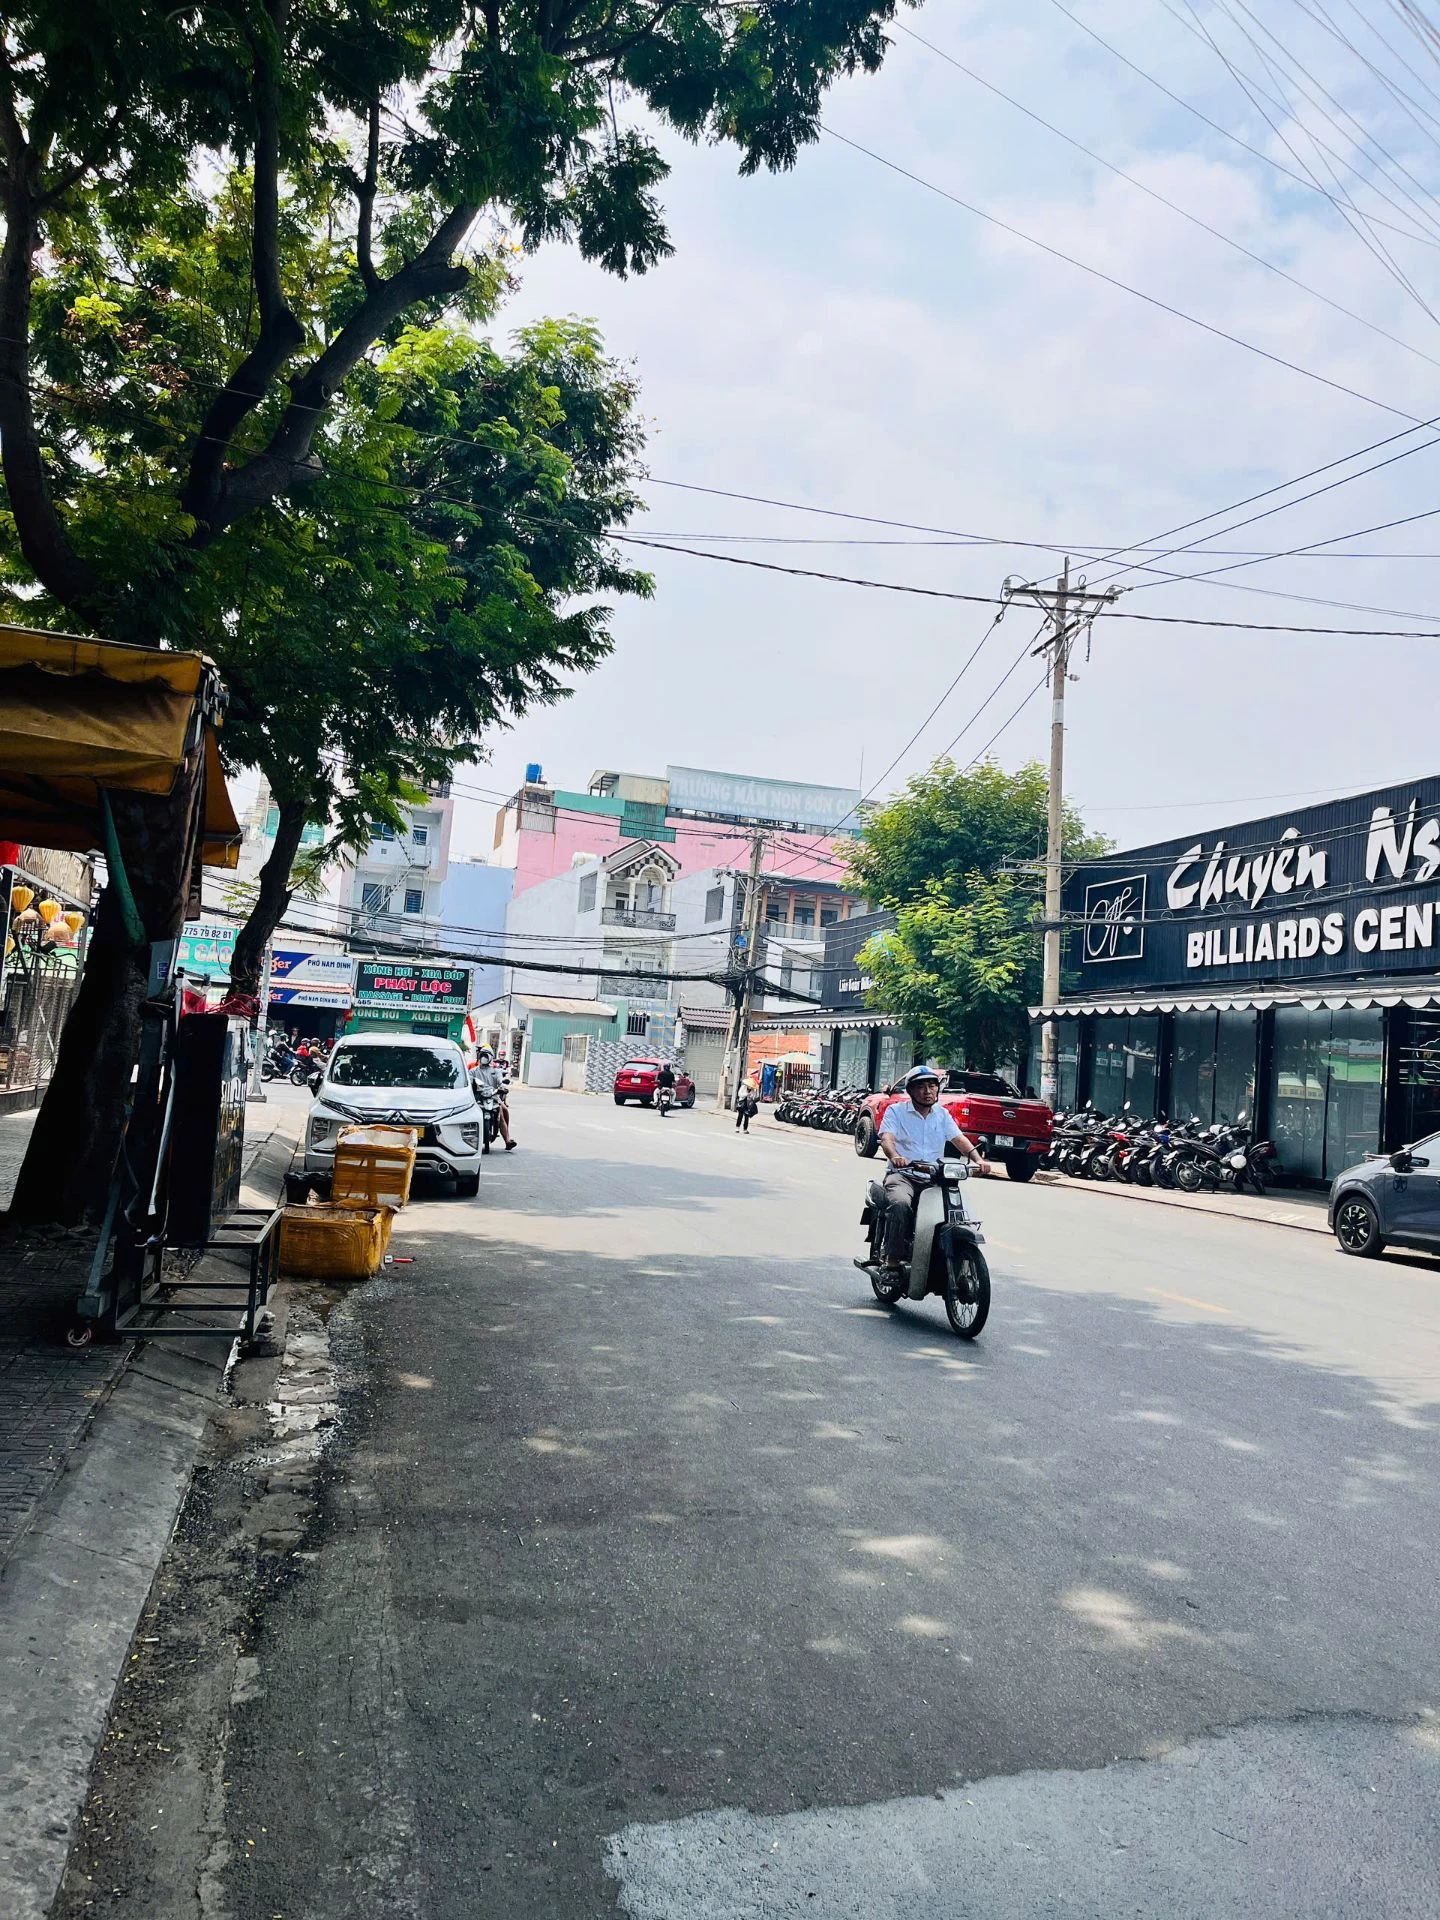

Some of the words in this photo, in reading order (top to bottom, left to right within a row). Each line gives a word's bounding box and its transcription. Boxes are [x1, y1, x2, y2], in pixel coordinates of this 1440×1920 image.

[771, 789, 801, 809] NON
[1167, 827, 1327, 912] Chuyên
[184, 927, 198, 936] 775
[200, 928, 209, 937] 79
[211, 929, 221, 938] 82
[223, 931, 232, 939] 81
[1187, 912, 1346, 968] BILLIARDS
[321, 960, 335, 968] NAM
[421, 968, 442, 979] XOA
[374, 976, 417, 991] PHÁT
[420, 979, 452, 995] LỘC
[358, 990, 403, 1001] MASSAGE
[410, 993, 435, 1003] BODY
[442, 995, 465, 1005] FOOT
